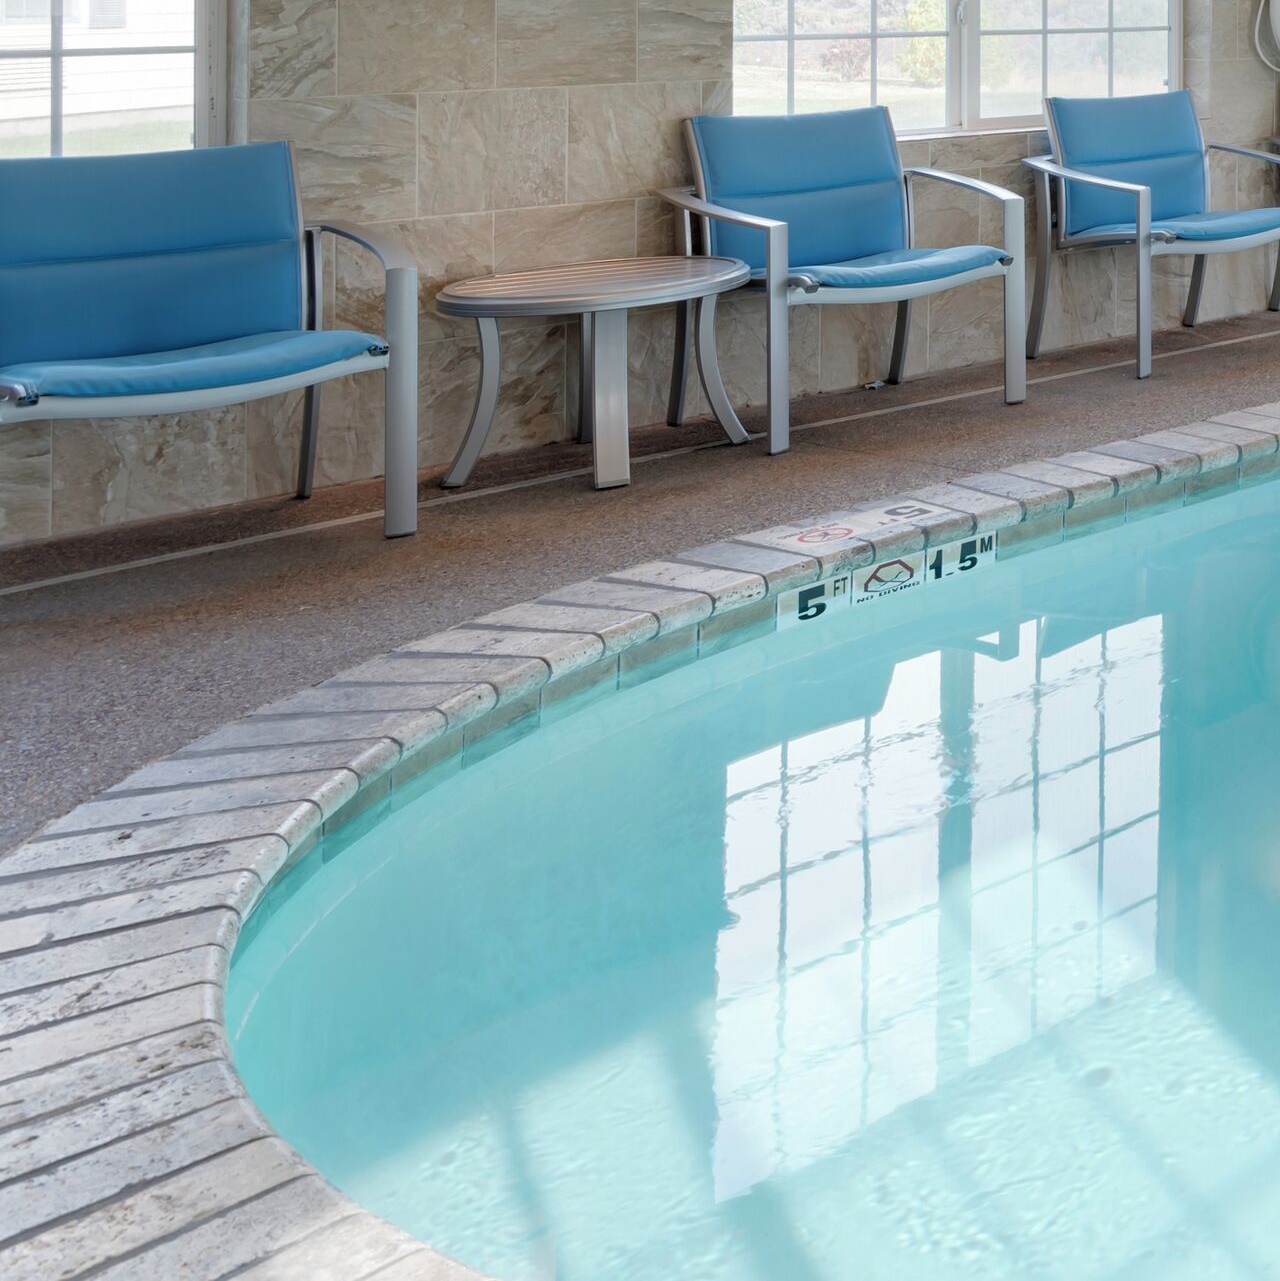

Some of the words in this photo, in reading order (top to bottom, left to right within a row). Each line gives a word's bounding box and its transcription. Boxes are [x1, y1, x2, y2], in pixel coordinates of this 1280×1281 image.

[884, 505, 932, 519] 5
[980, 535, 993, 554] M
[798, 584, 827, 620] 5
[833, 576, 848, 597] FT
[856, 595, 874, 604] NO
[879, 581, 920, 597] DIVING
